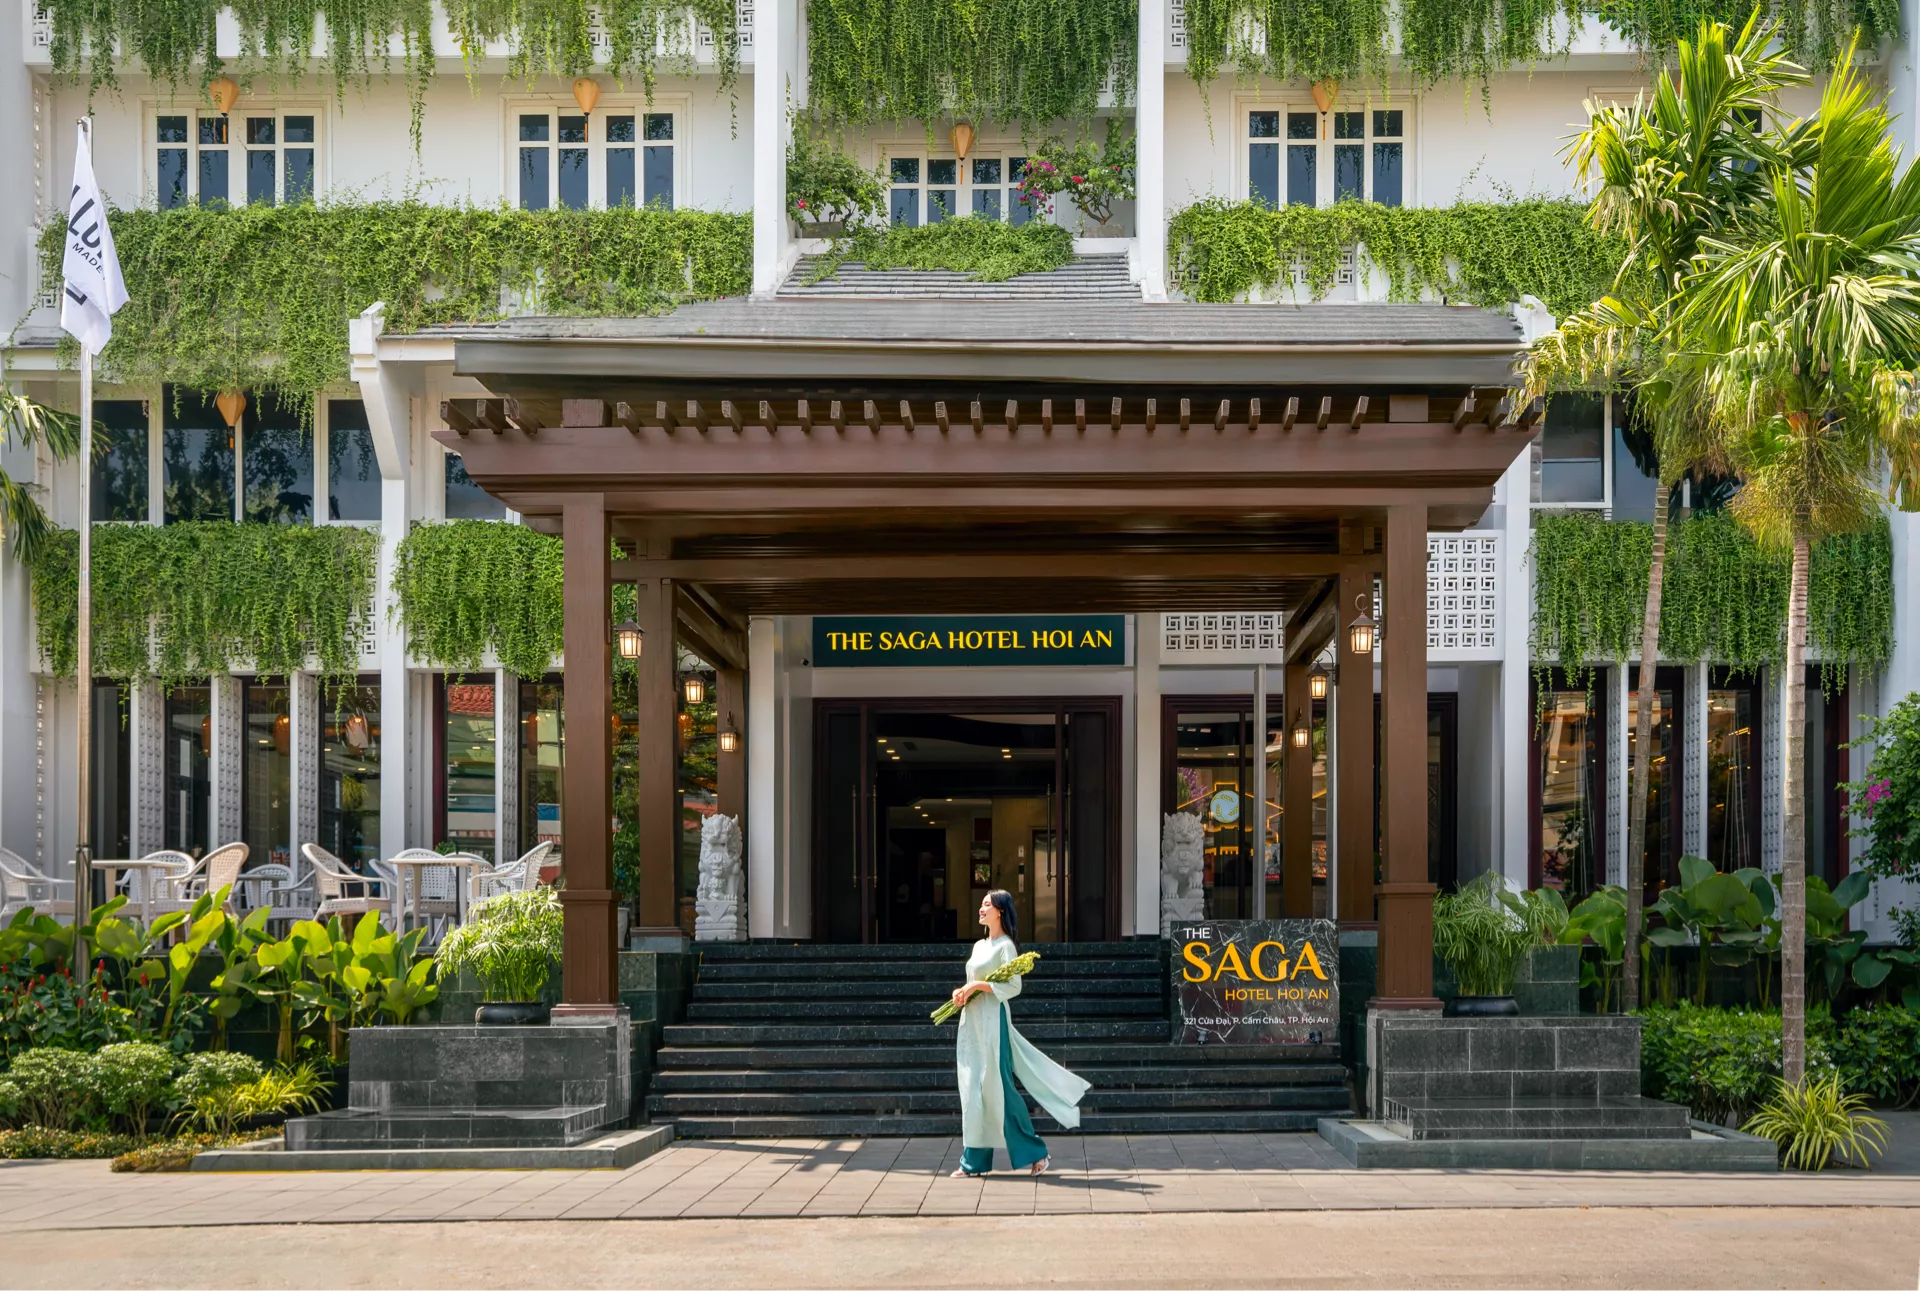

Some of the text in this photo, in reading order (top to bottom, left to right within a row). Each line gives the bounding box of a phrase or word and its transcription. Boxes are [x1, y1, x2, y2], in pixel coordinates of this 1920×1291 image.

[72, 242, 104, 274] MADE
[827, 630, 1112, 650] THE SAGA HOTEL HOI AN
[1184, 928, 1211, 939] THE
[1183, 941, 1329, 982] SAGA
[1225, 988, 1329, 1000] HOTEL HOI AN
[1184, 1017, 1196, 1025] 321
[1233, 1017, 1241, 1025] P.
[1316, 1016, 1329, 1024] An
